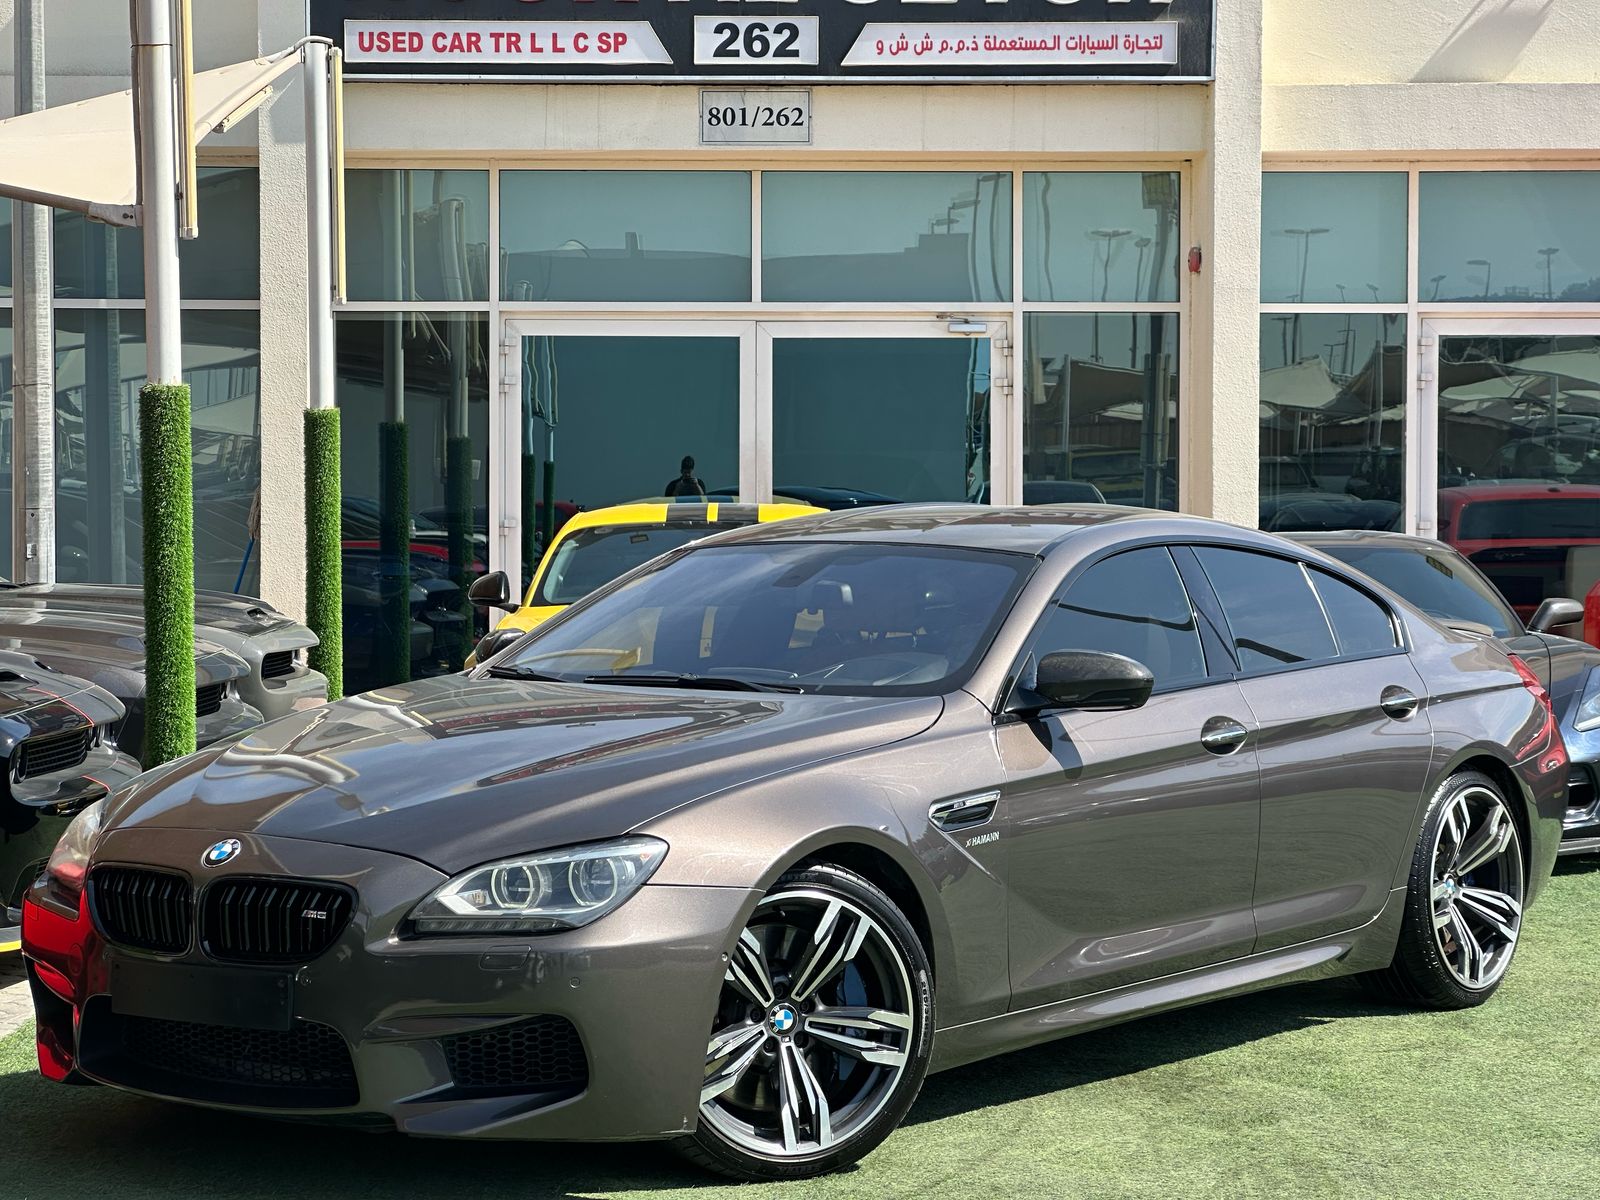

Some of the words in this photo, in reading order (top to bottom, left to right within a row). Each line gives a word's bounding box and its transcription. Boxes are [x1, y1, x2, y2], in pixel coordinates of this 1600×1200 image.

[358, 32, 424, 53] USED
[432, 32, 482, 53] CAR
[490, 32, 522, 53] TR
[530, 32, 544, 53] L
[552, 32, 566, 53] L
[573, 32, 589, 53] C
[597, 32, 628, 53] SP
[712, 22, 800, 58] 262
[876, 39, 885, 55] و
[889, 32, 909, 56] ش
[913, 32, 934, 56] ش
[983, 35, 1061, 52] المستعملة
[1065, 34, 1120, 55] السيارات
[1123, 34, 1163, 54] لتجارة
[707, 106, 805, 128] 801/262
[971, 831, 1000, 847] HAMANN
